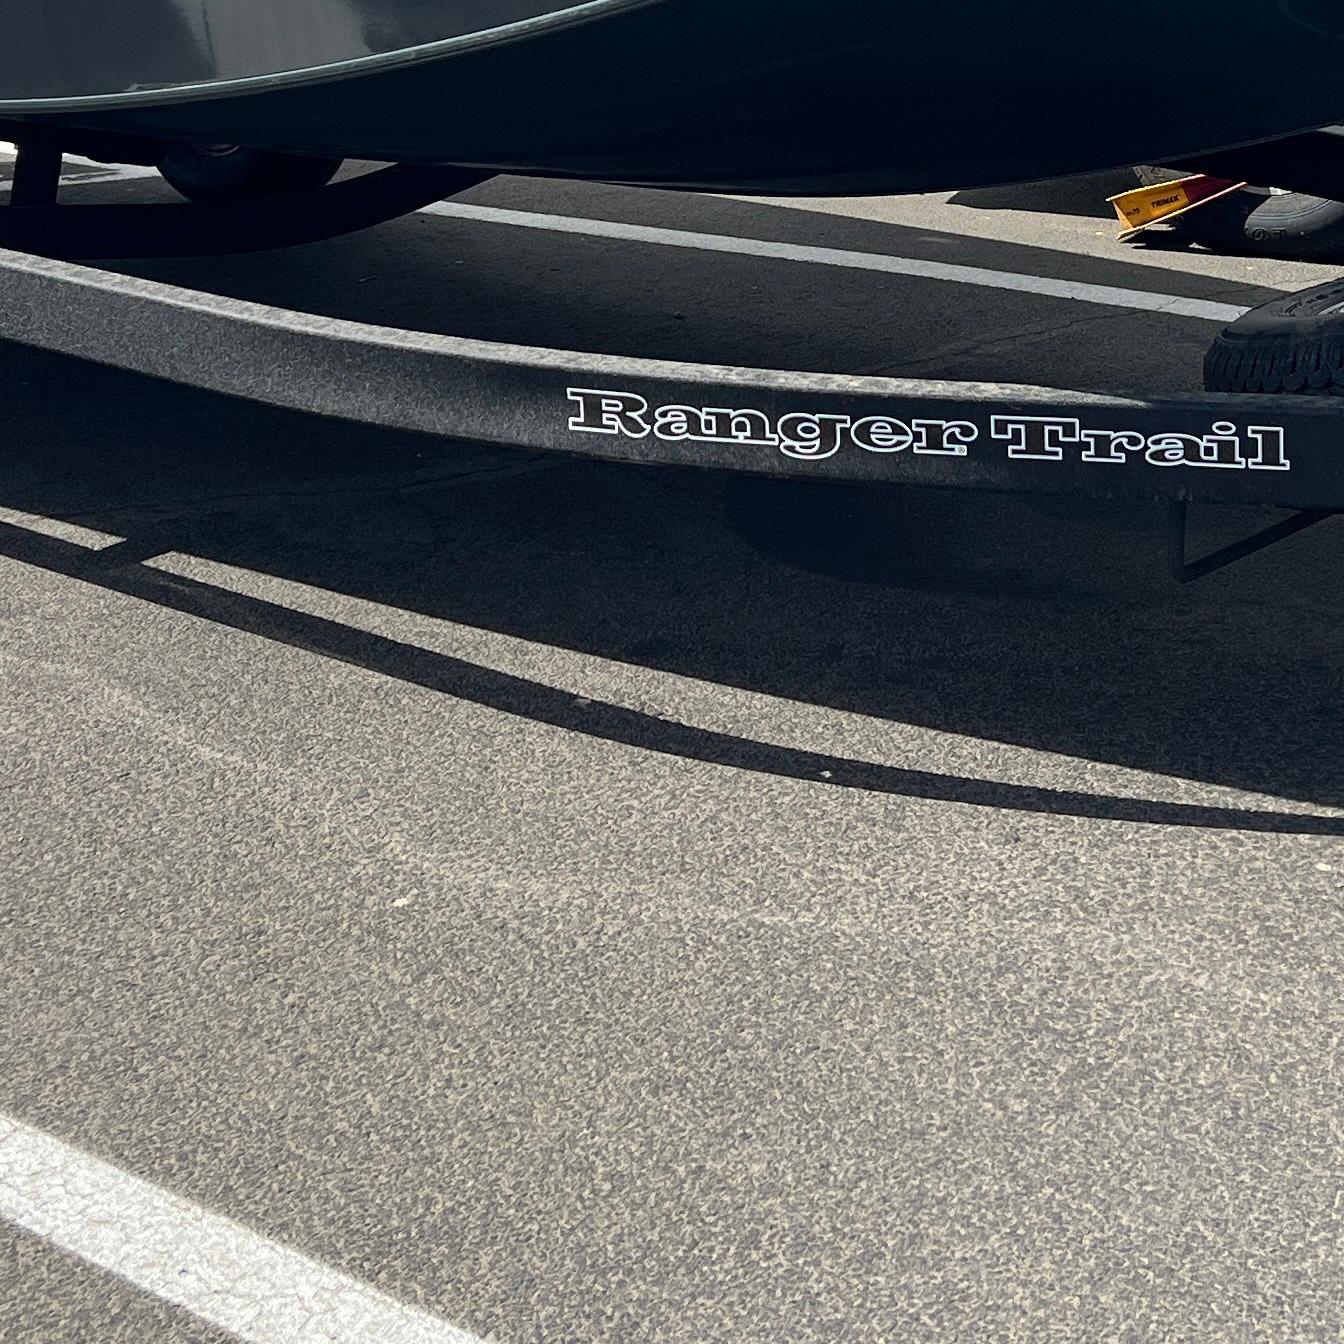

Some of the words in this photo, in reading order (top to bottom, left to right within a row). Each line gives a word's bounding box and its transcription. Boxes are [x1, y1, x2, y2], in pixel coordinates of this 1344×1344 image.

[1150, 194, 1181, 209] TRIMAX
[565, 386, 978, 459] Ranger
[990, 414, 1291, 471] Trail
